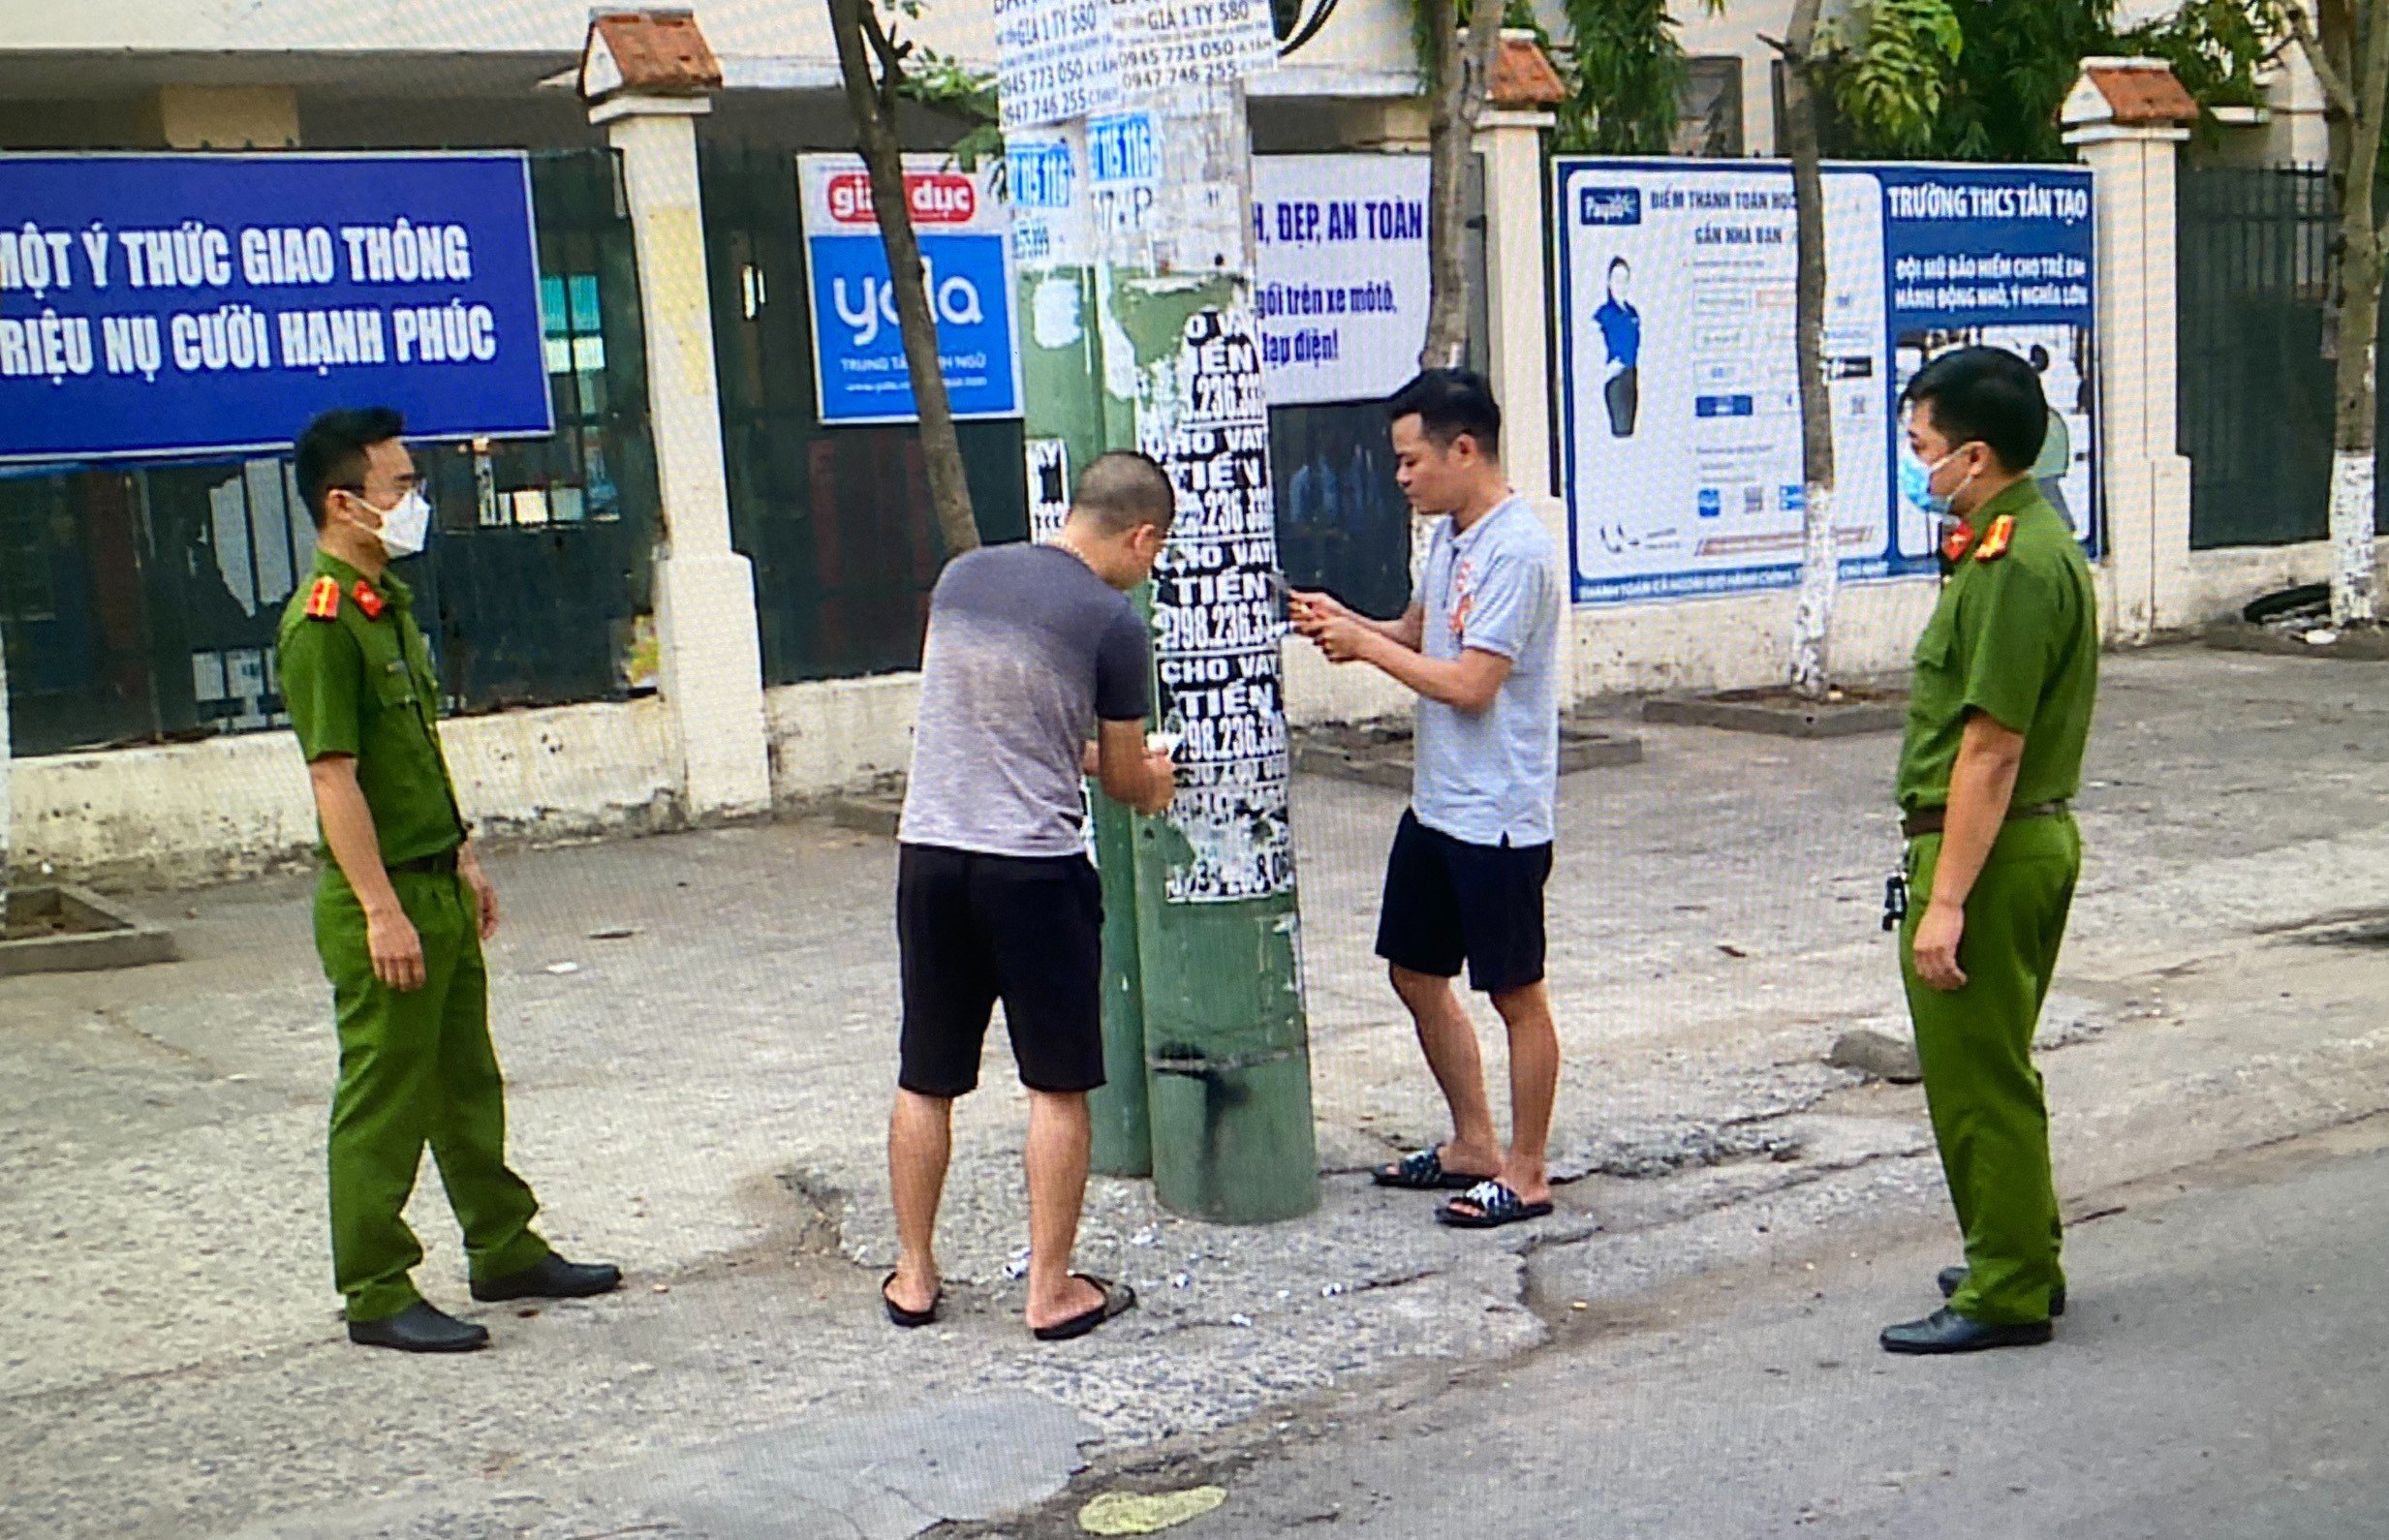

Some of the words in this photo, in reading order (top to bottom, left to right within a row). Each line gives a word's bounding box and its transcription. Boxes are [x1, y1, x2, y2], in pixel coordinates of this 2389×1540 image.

[1200, 39, 1234, 59] 050
[1277, 200, 1321, 249] ĐẸP,
[1328, 200, 1357, 240] AN
[1365, 195, 1423, 240] TOÀN
[1887, 183, 1968, 218] TRƯỜNG
[1970, 187, 2015, 217] THCS
[2055, 188, 2089, 226] TẠO
[0, 221, 72, 299] MỘT
[81, 221, 109, 288] Ý
[118, 220, 232, 289] THỨC
[240, 226, 335, 285] GIAO
[341, 216, 472, 283] THÔNG
[1326, 287, 1346, 314] xe
[0, 308, 94, 385] RIỆU
[102, 316, 162, 384] NỤ
[171, 303, 271, 371] CƯỜI
[278, 309, 387, 376] HẠNH
[392, 296, 497, 363] PHÚC
[891, 352, 909, 370] TÂ
[1161, 658, 1229, 684] CHO
